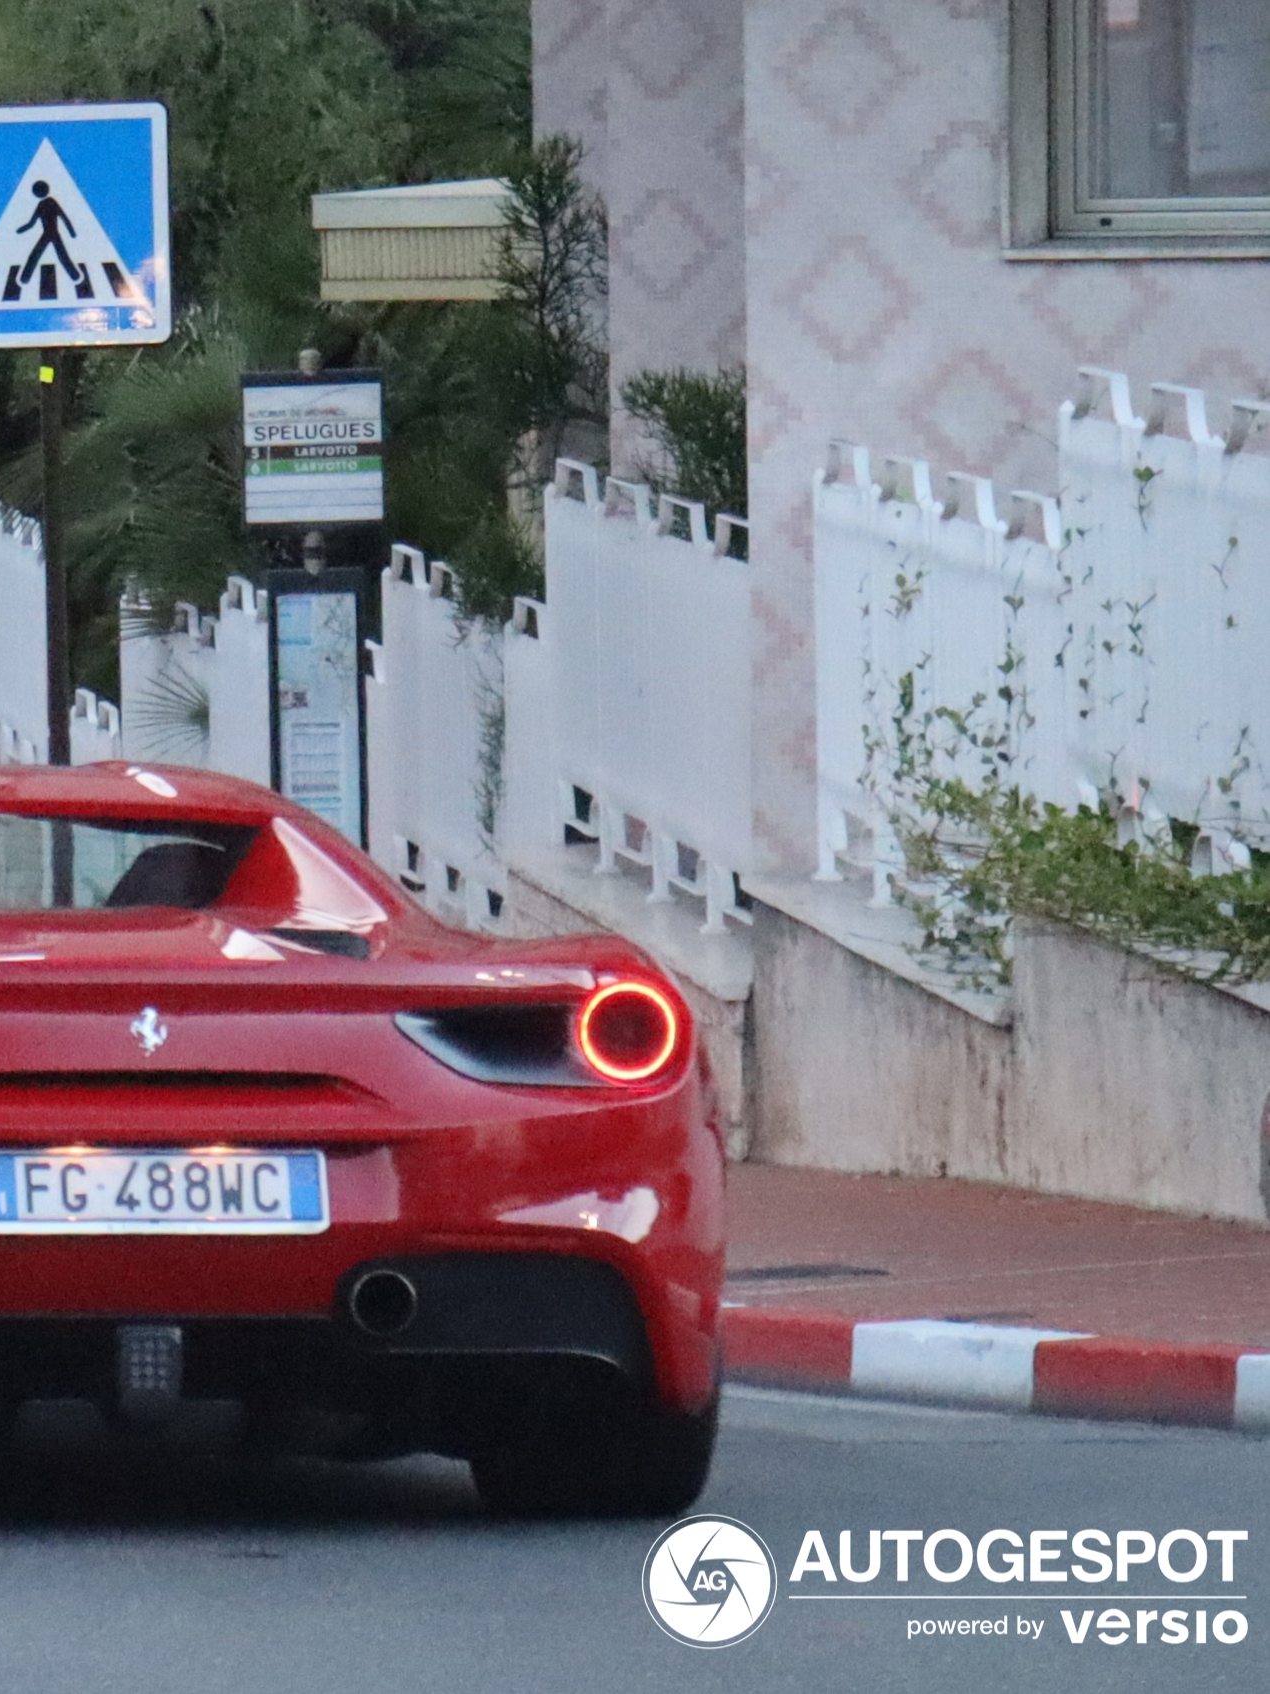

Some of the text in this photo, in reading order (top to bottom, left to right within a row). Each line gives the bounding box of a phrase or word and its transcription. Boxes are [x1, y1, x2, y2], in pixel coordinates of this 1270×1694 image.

[254, 422, 375, 442] SPELUGUES
[294, 445, 358, 457] LARVOTTO
[250, 460, 358, 475] 6 LARVOTTO
[23, 1161, 88, 1214] FG
[114, 1160, 281, 1214] 488WC
